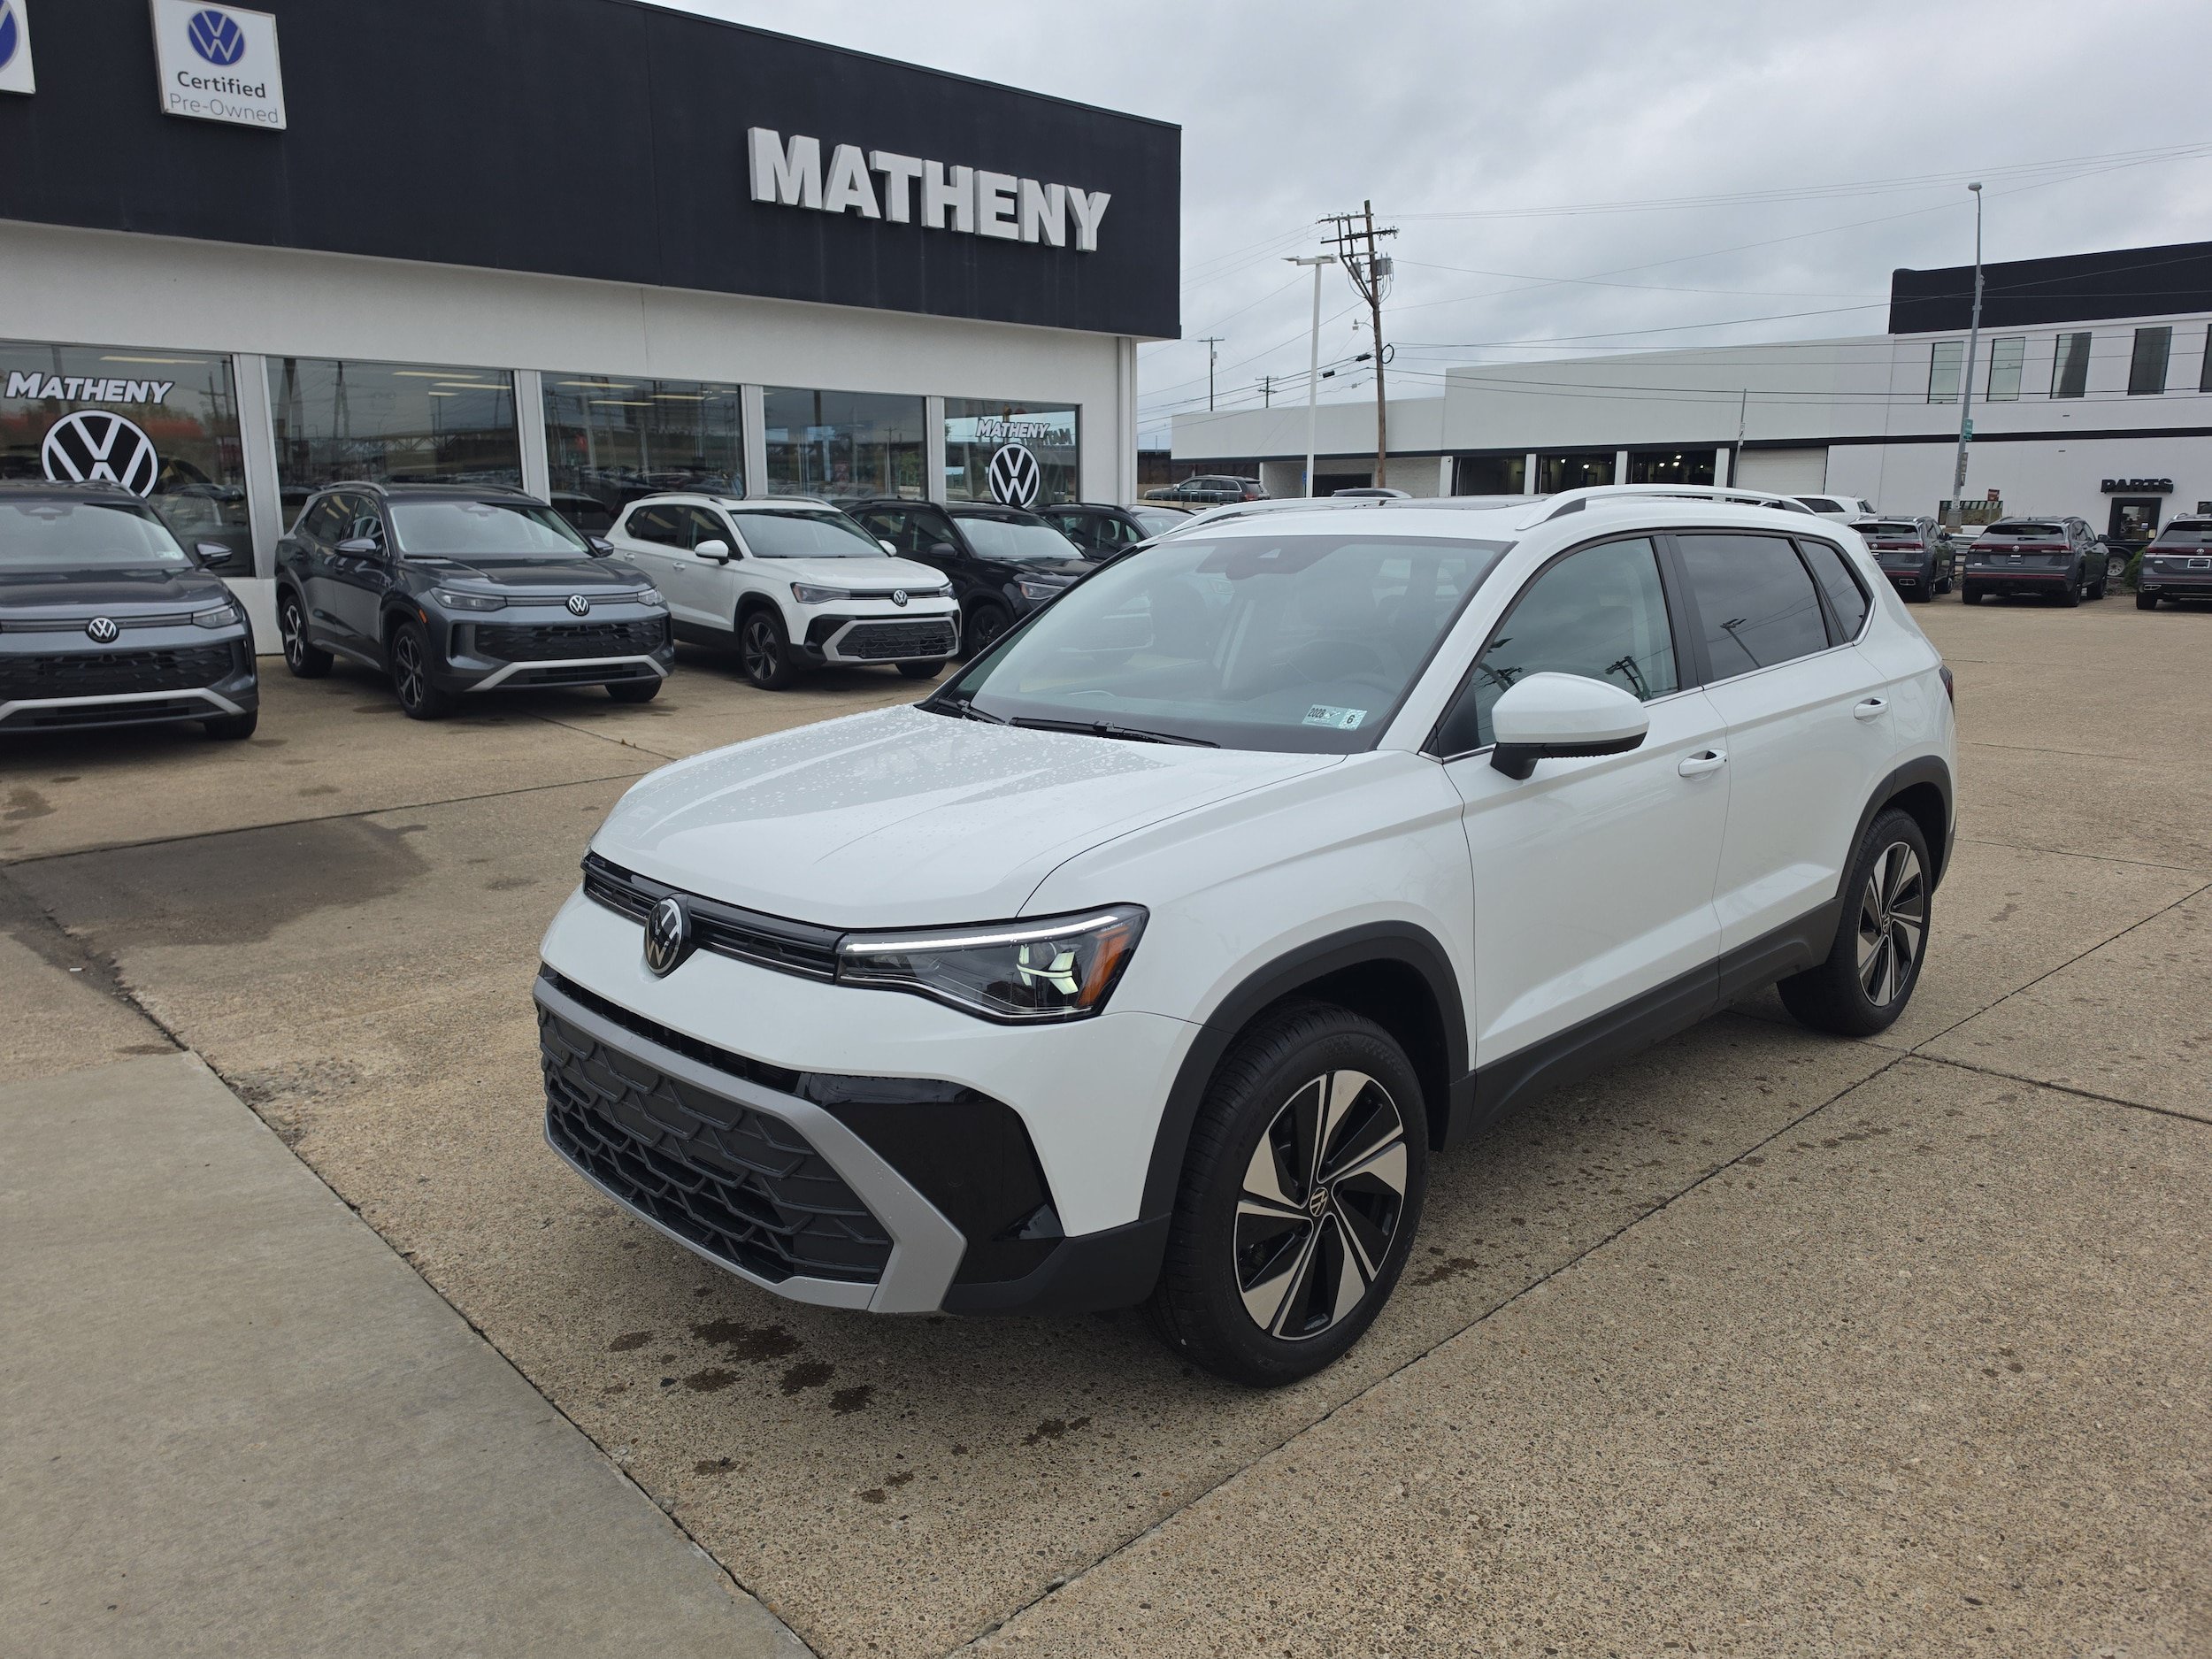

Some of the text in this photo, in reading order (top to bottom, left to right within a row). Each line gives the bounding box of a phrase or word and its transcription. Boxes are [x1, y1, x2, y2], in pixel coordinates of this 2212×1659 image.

[177, 71, 266, 98] Certified
[169, 93, 278, 124] Pre-Owned
[748, 127, 1111, 251] MATHENY
[5, 371, 174, 403] MATHENY
[975, 419, 1050, 439] MATHENY
[2101, 479, 2173, 493] PARTS
[1347, 715, 1355, 724] 6
